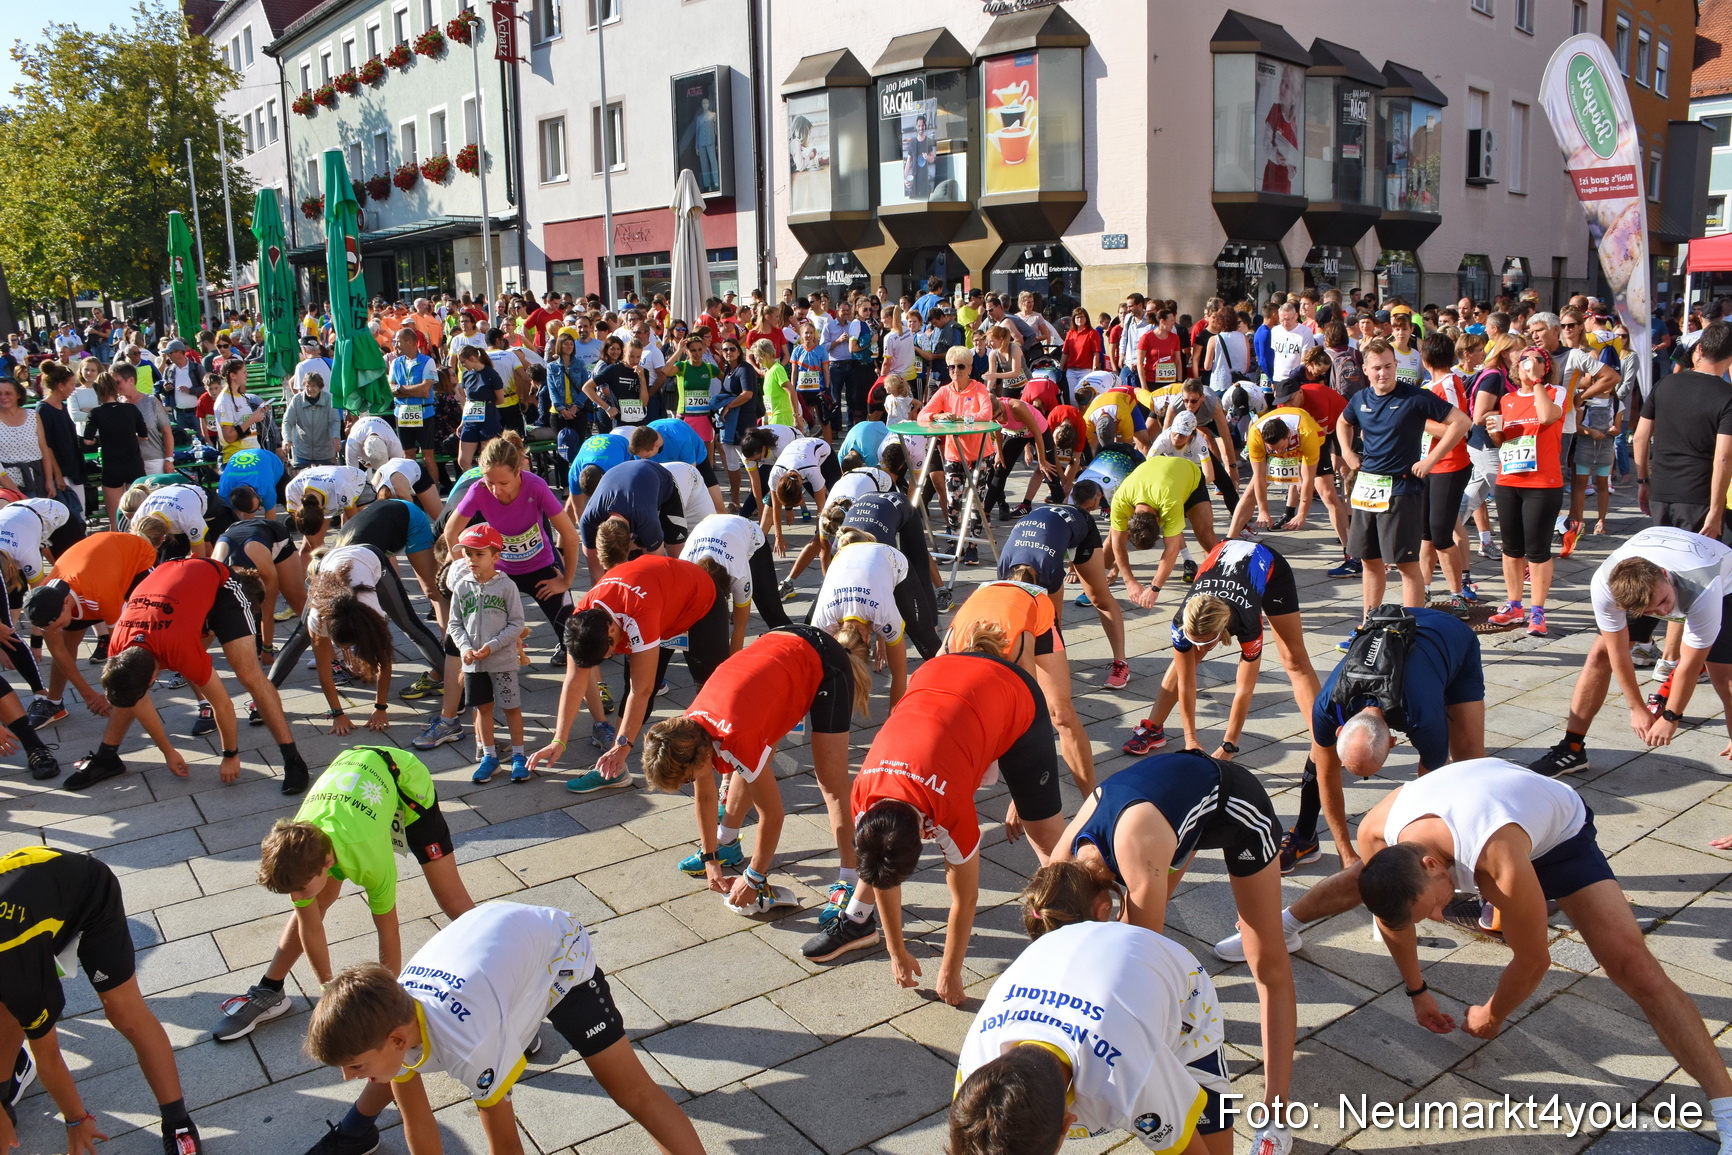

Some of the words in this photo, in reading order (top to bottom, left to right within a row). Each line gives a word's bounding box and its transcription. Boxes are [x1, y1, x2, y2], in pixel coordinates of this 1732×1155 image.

[497, 11, 511, 57] Achatz
[885, 83, 897, 94] 100
[898, 77, 918, 91] Jahre
[800, 377, 818, 385] 5091
[688, 398, 708, 406] 2704
[466, 407, 481, 415] 075
[1503, 449, 1530, 462] 2517
[1269, 466, 1295, 476] 5101
[849, 516, 889, 533] Beratung
[1022, 530, 1037, 538] mit
[502, 537, 538, 552] 2616
[1014, 540, 1056, 557] Beratung
[631, 585, 647, 599] TV
[1195, 579, 1248, 595] MÜLLER
[868, 599, 879, 609] 20.
[151, 620, 173, 631] ASV
[1364, 636, 1383, 667] CAMELBAK
[717, 719, 732, 734] TV
[369, 768, 389, 794] Sektion
[924, 773, 948, 796] TV
[352, 800, 377, 821] TEAM
[554, 982, 565, 996] 2019
[450, 997, 471, 1022] 20.
[1003, 984, 1105, 1021] Stadtlauf
[585, 1021, 607, 1039] JAKO
[1092, 1034, 1122, 1067] 20.
